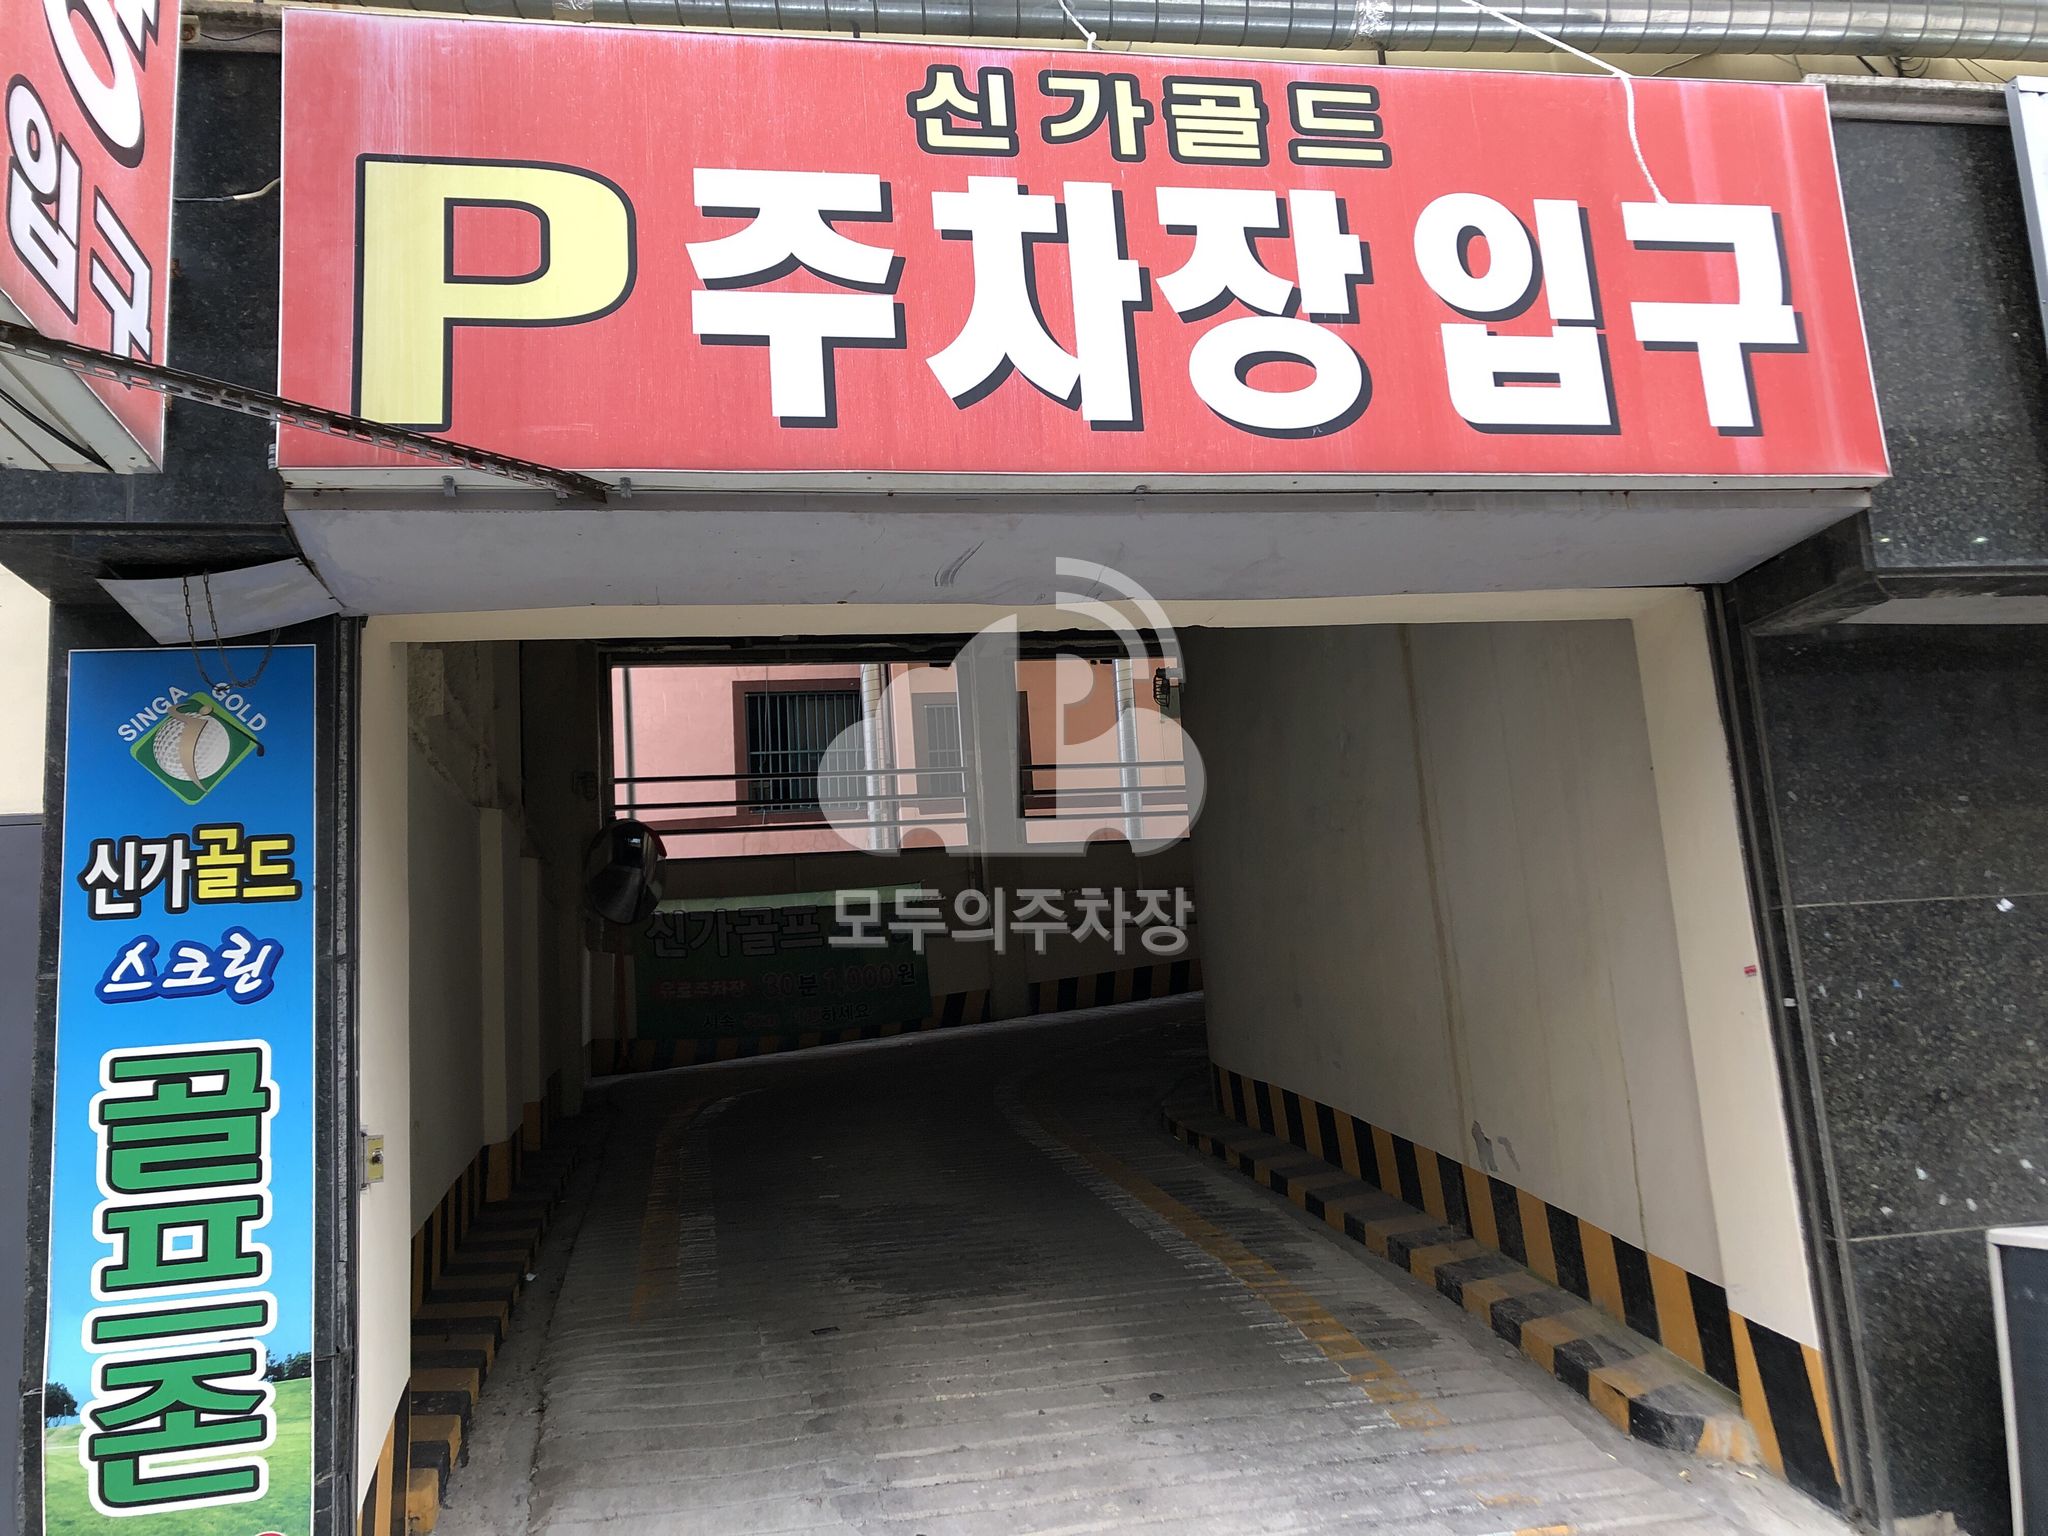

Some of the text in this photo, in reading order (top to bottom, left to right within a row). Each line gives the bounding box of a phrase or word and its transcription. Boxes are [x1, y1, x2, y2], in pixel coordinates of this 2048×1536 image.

[907, 64, 1390, 167] 신가골드
[353, 153, 1809, 439] P 주차장 입구
[117, 682, 267, 742] SINGA GOLD
[78, 823, 302, 920] 신가골드
[96, 926, 283, 1004] 스크린
[646, 905, 826, 959] 신가골프
[88, 1046, 273, 1509] 골프존
